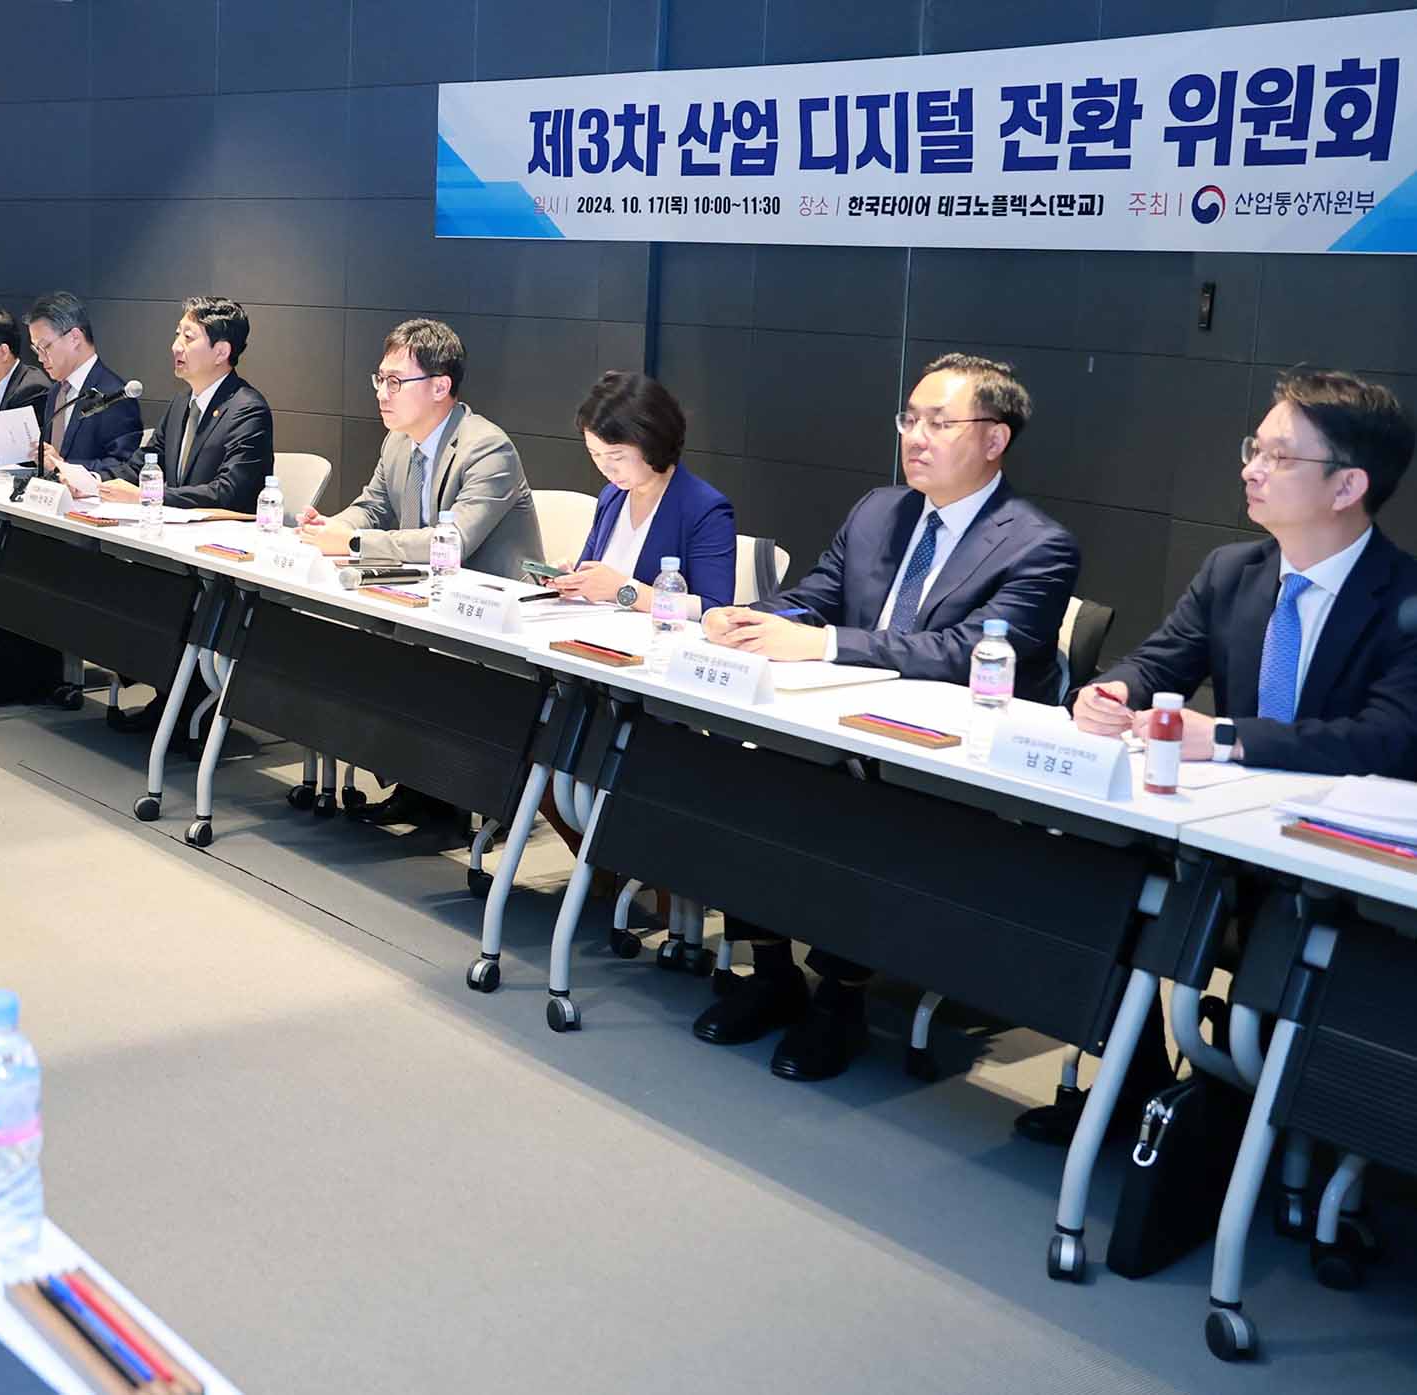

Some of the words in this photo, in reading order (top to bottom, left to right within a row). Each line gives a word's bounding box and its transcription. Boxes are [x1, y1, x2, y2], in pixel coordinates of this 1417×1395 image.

[527, 103, 666, 177] 제3차
[677, 98, 779, 177] 산업
[798, 87, 974, 175] 디지털
[999, 77, 1144, 172] 전환
[1163, 57, 1400, 167] 위원회
[576, 196, 615, 214] 2024.
[621, 196, 642, 214] 10.
[648, 196, 688, 215] 17(목)
[694, 196, 781, 215] 10:00~11:30
[798, 194, 831, 217] 장소
[847, 195, 931, 217] 한국타이어
[937, 194, 1105, 217] 테크노플렉스(판교)
[1127, 191, 1168, 217] 주최
[1235, 190, 1375, 217] 산업통상자원부
[1026, 751, 1073, 776] 남경모
